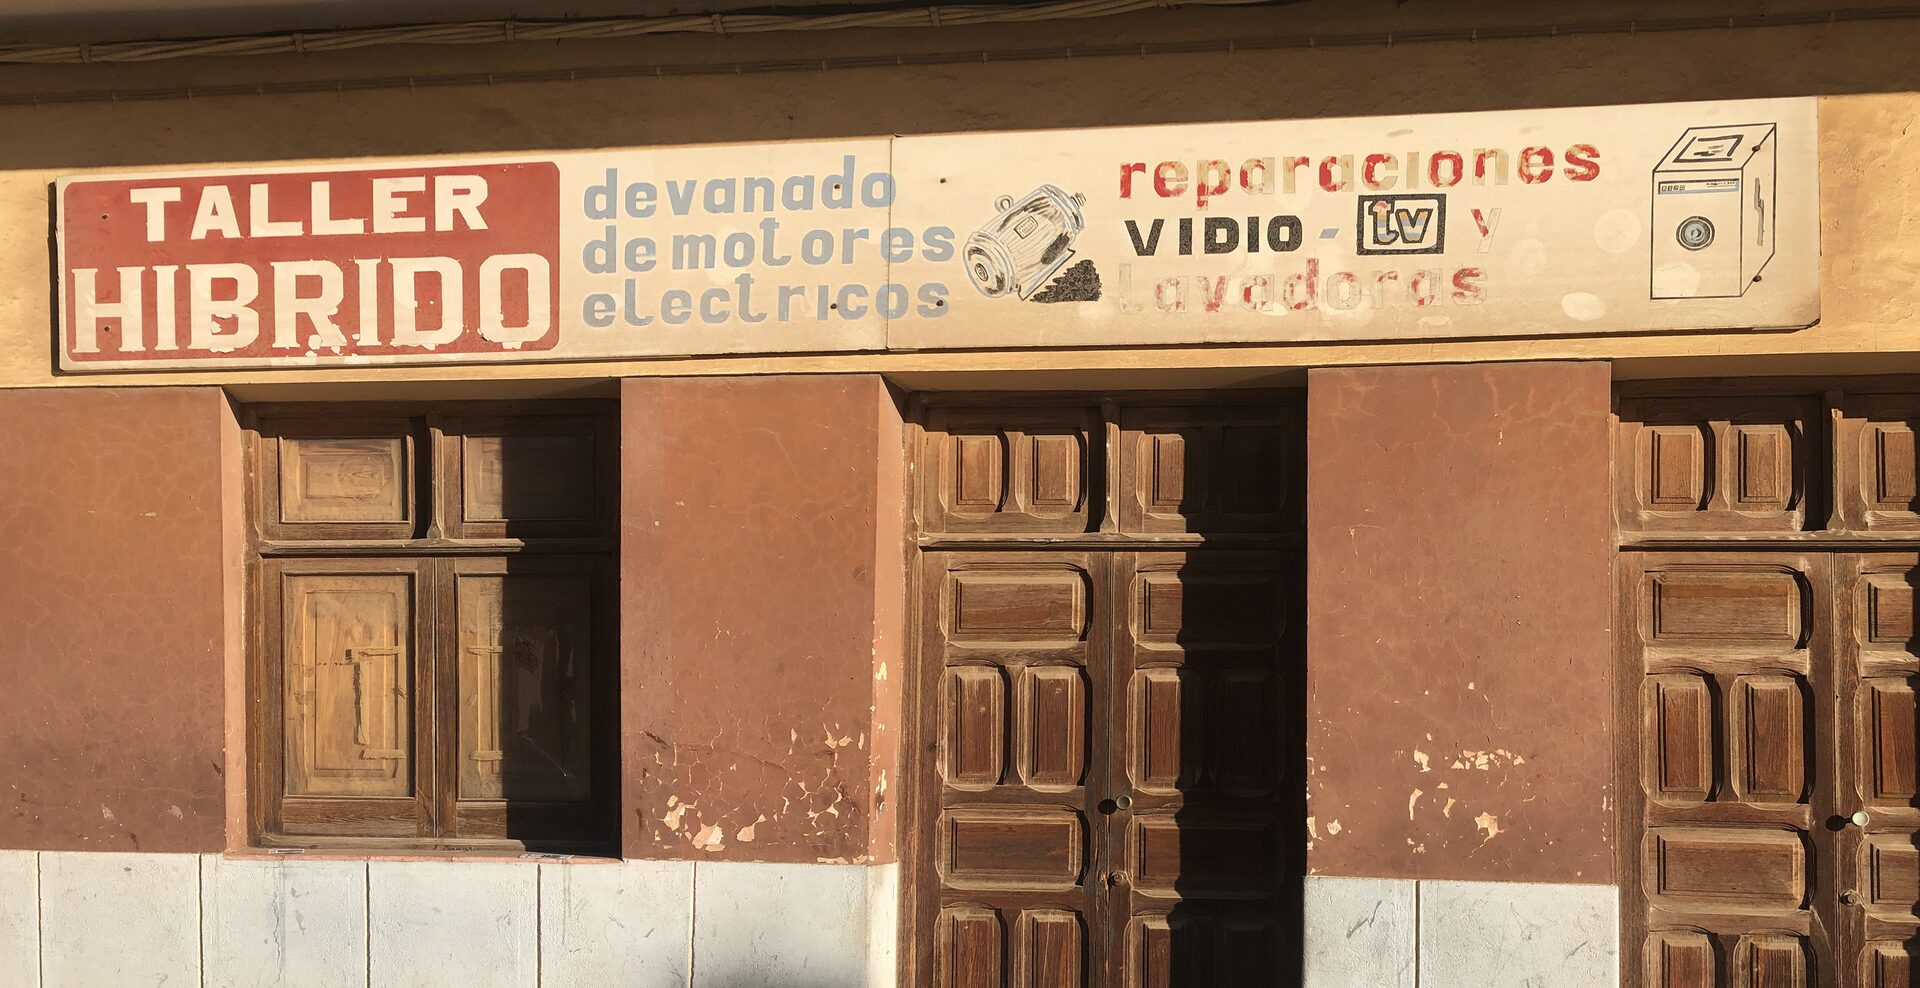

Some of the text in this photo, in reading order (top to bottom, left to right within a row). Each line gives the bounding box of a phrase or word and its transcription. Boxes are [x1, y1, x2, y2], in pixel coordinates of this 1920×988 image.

[130, 175, 488, 242] TALLER
[583, 155, 896, 220] devanado
[1120, 144, 1601, 211] reparaciones
[582, 217, 955, 274] de motores
[1125, 215, 1303, 256] VIDIO
[1369, 200, 1433, 245] tv
[72, 252, 550, 354] HIBRIDO
[582, 272, 950, 328] electricos
